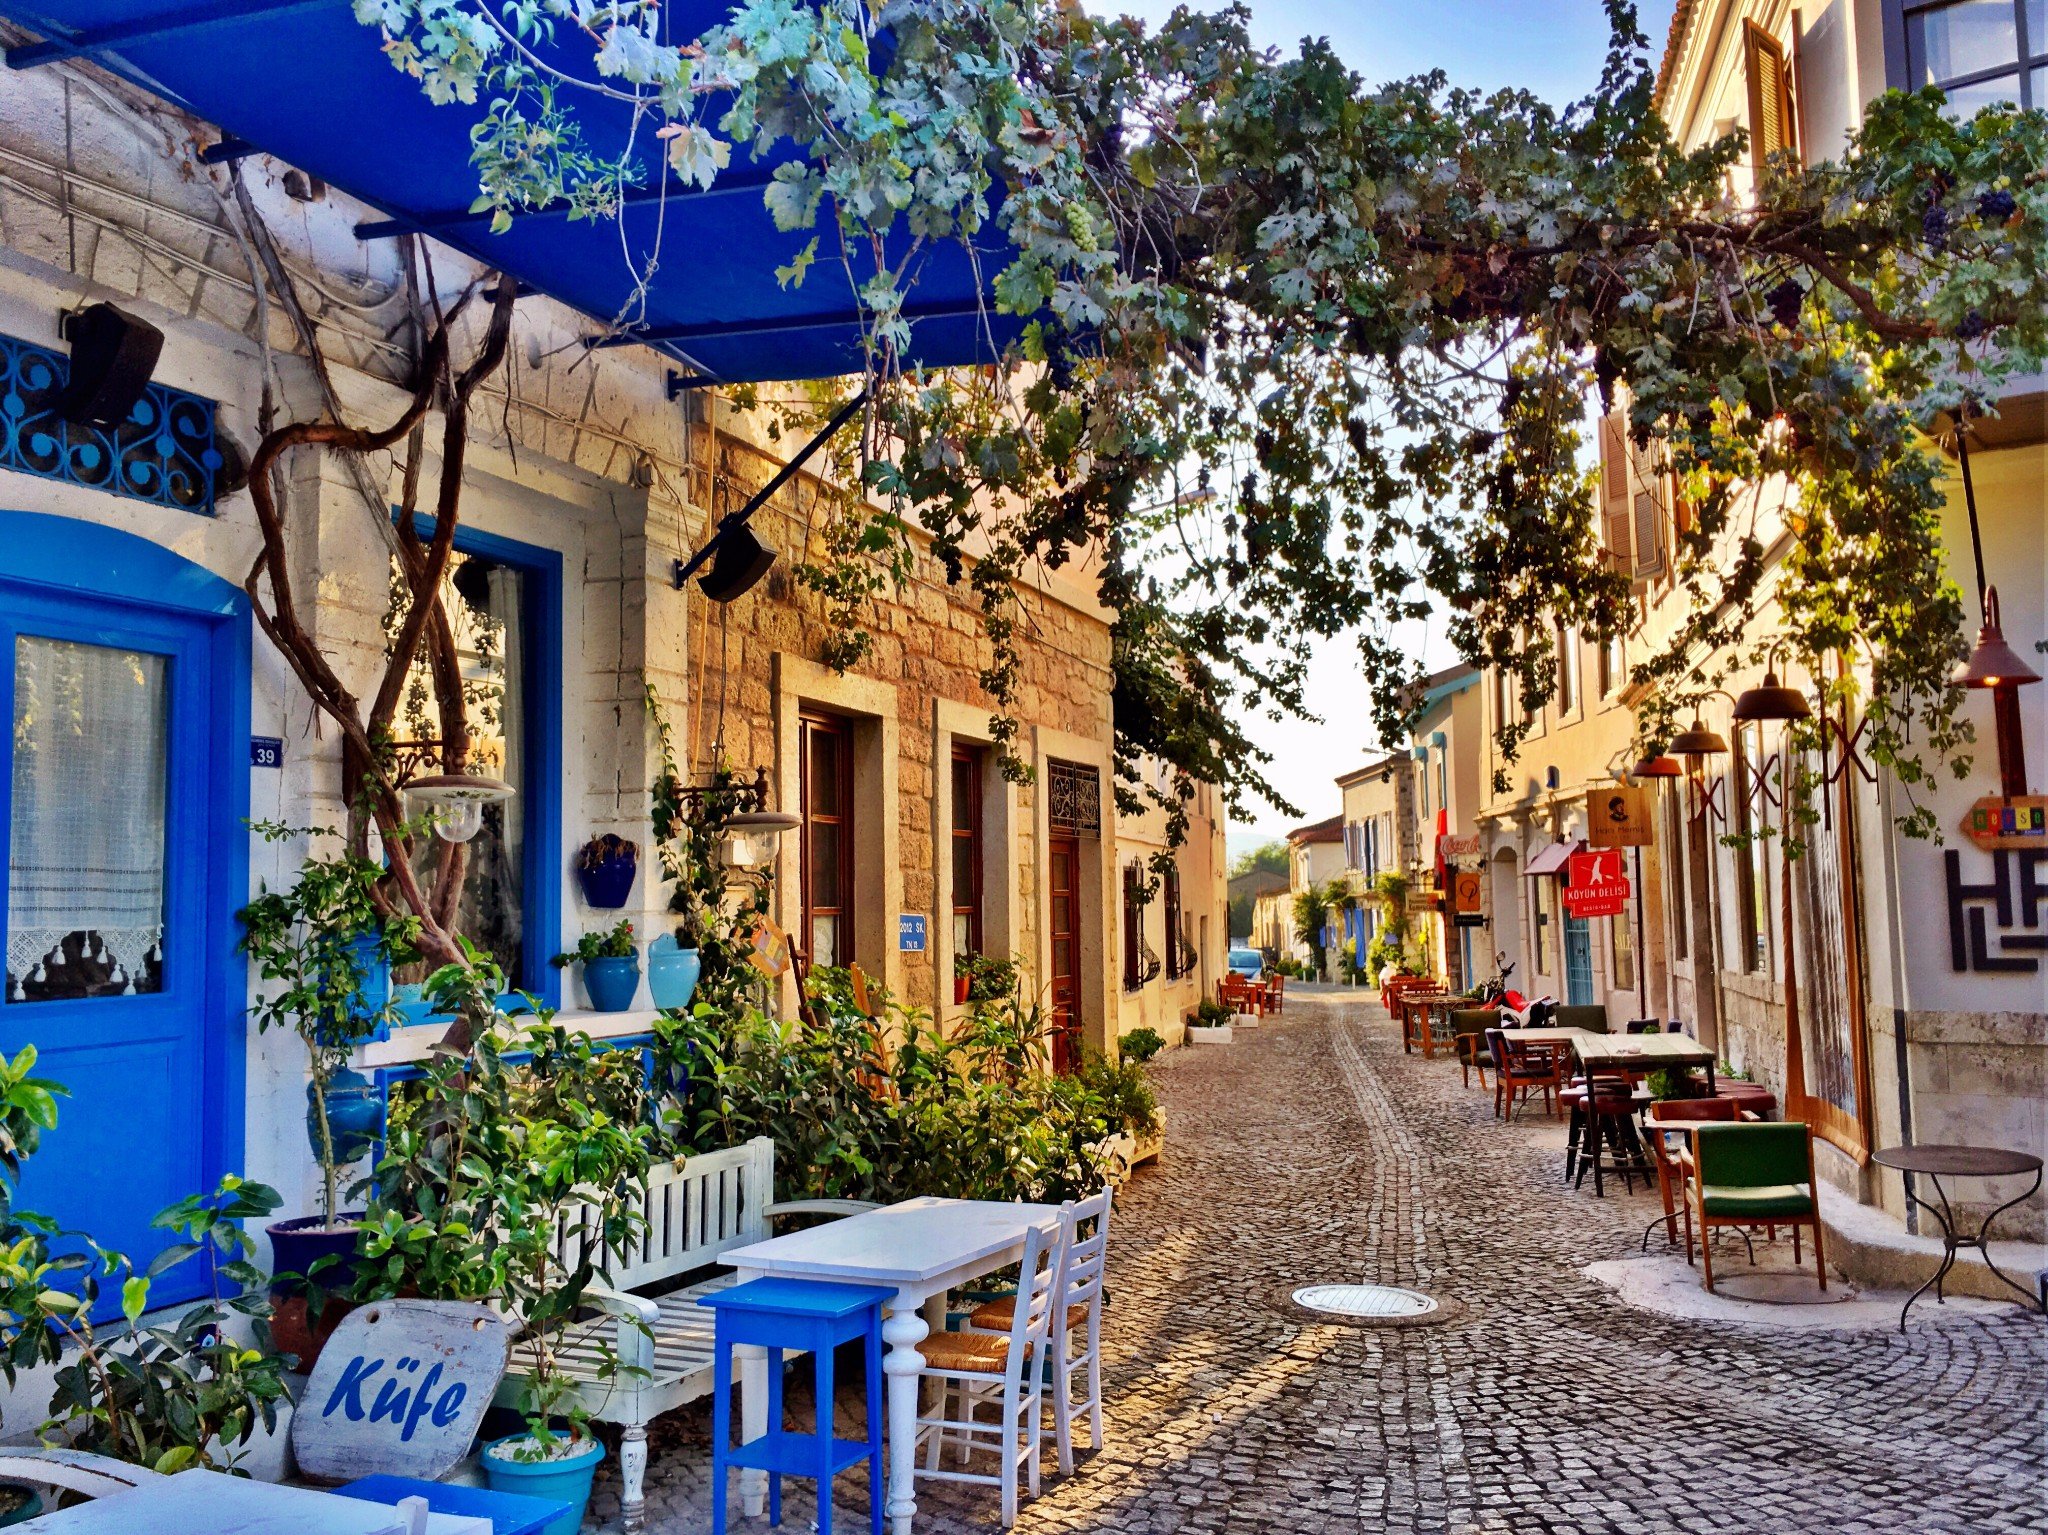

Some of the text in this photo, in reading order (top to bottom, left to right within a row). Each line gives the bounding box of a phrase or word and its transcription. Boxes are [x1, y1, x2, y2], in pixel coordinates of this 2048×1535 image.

[257, 748, 275, 764] 39
[1568, 883, 1626, 901] KÖYÜN DELİSİ
[900, 922, 913, 933] 2012
[322, 1356, 467, 1442] Küfe
